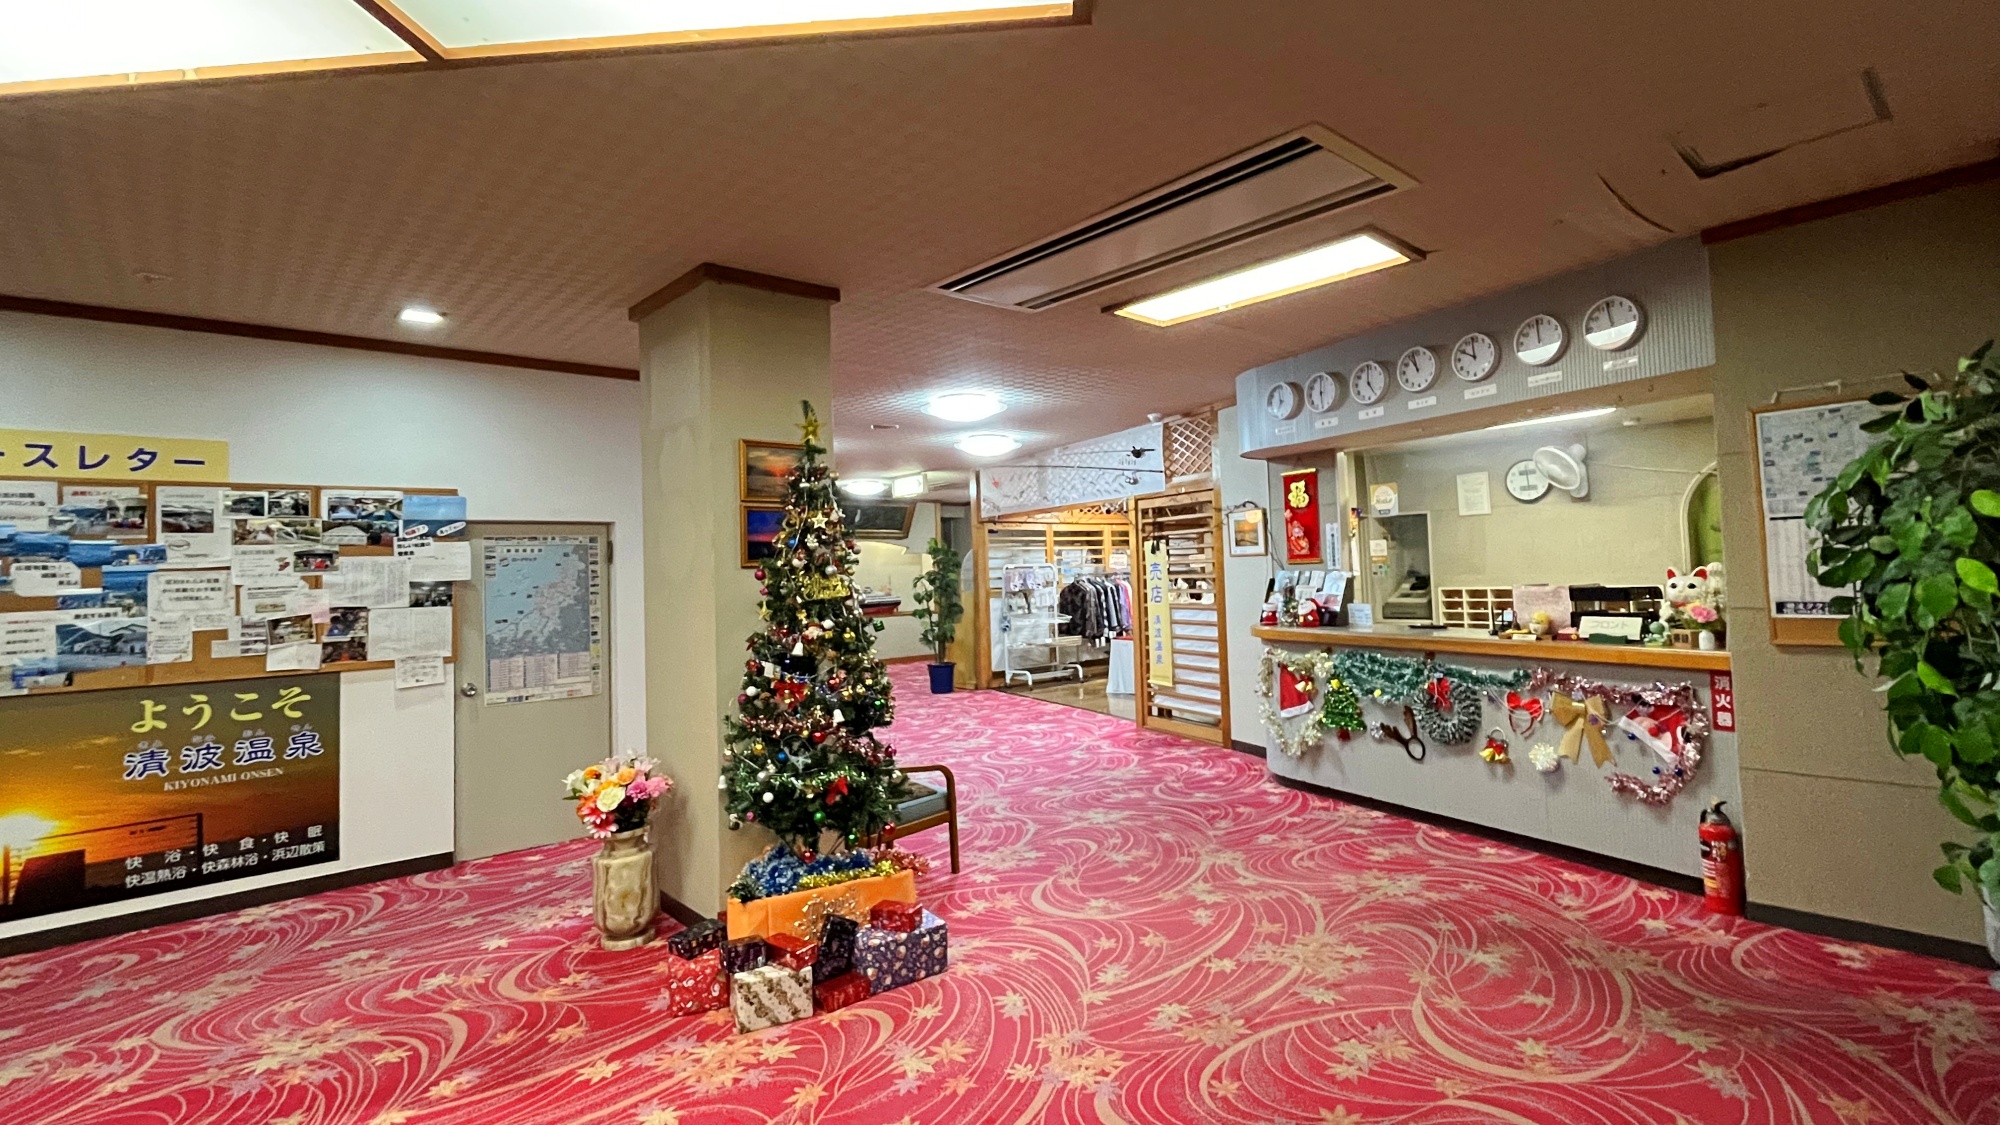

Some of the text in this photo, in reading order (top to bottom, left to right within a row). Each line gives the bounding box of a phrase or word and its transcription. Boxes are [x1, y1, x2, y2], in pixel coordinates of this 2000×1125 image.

[0, 443, 206, 472] スレター
[1149, 561, 1163, 604] 売店
[1591, 619, 1629, 629] フロント
[131, 686, 311, 733] ようこそ
[123, 730, 324, 780] 清波温泉
[163, 766, 285, 791] KIYONAMI ONSEN
